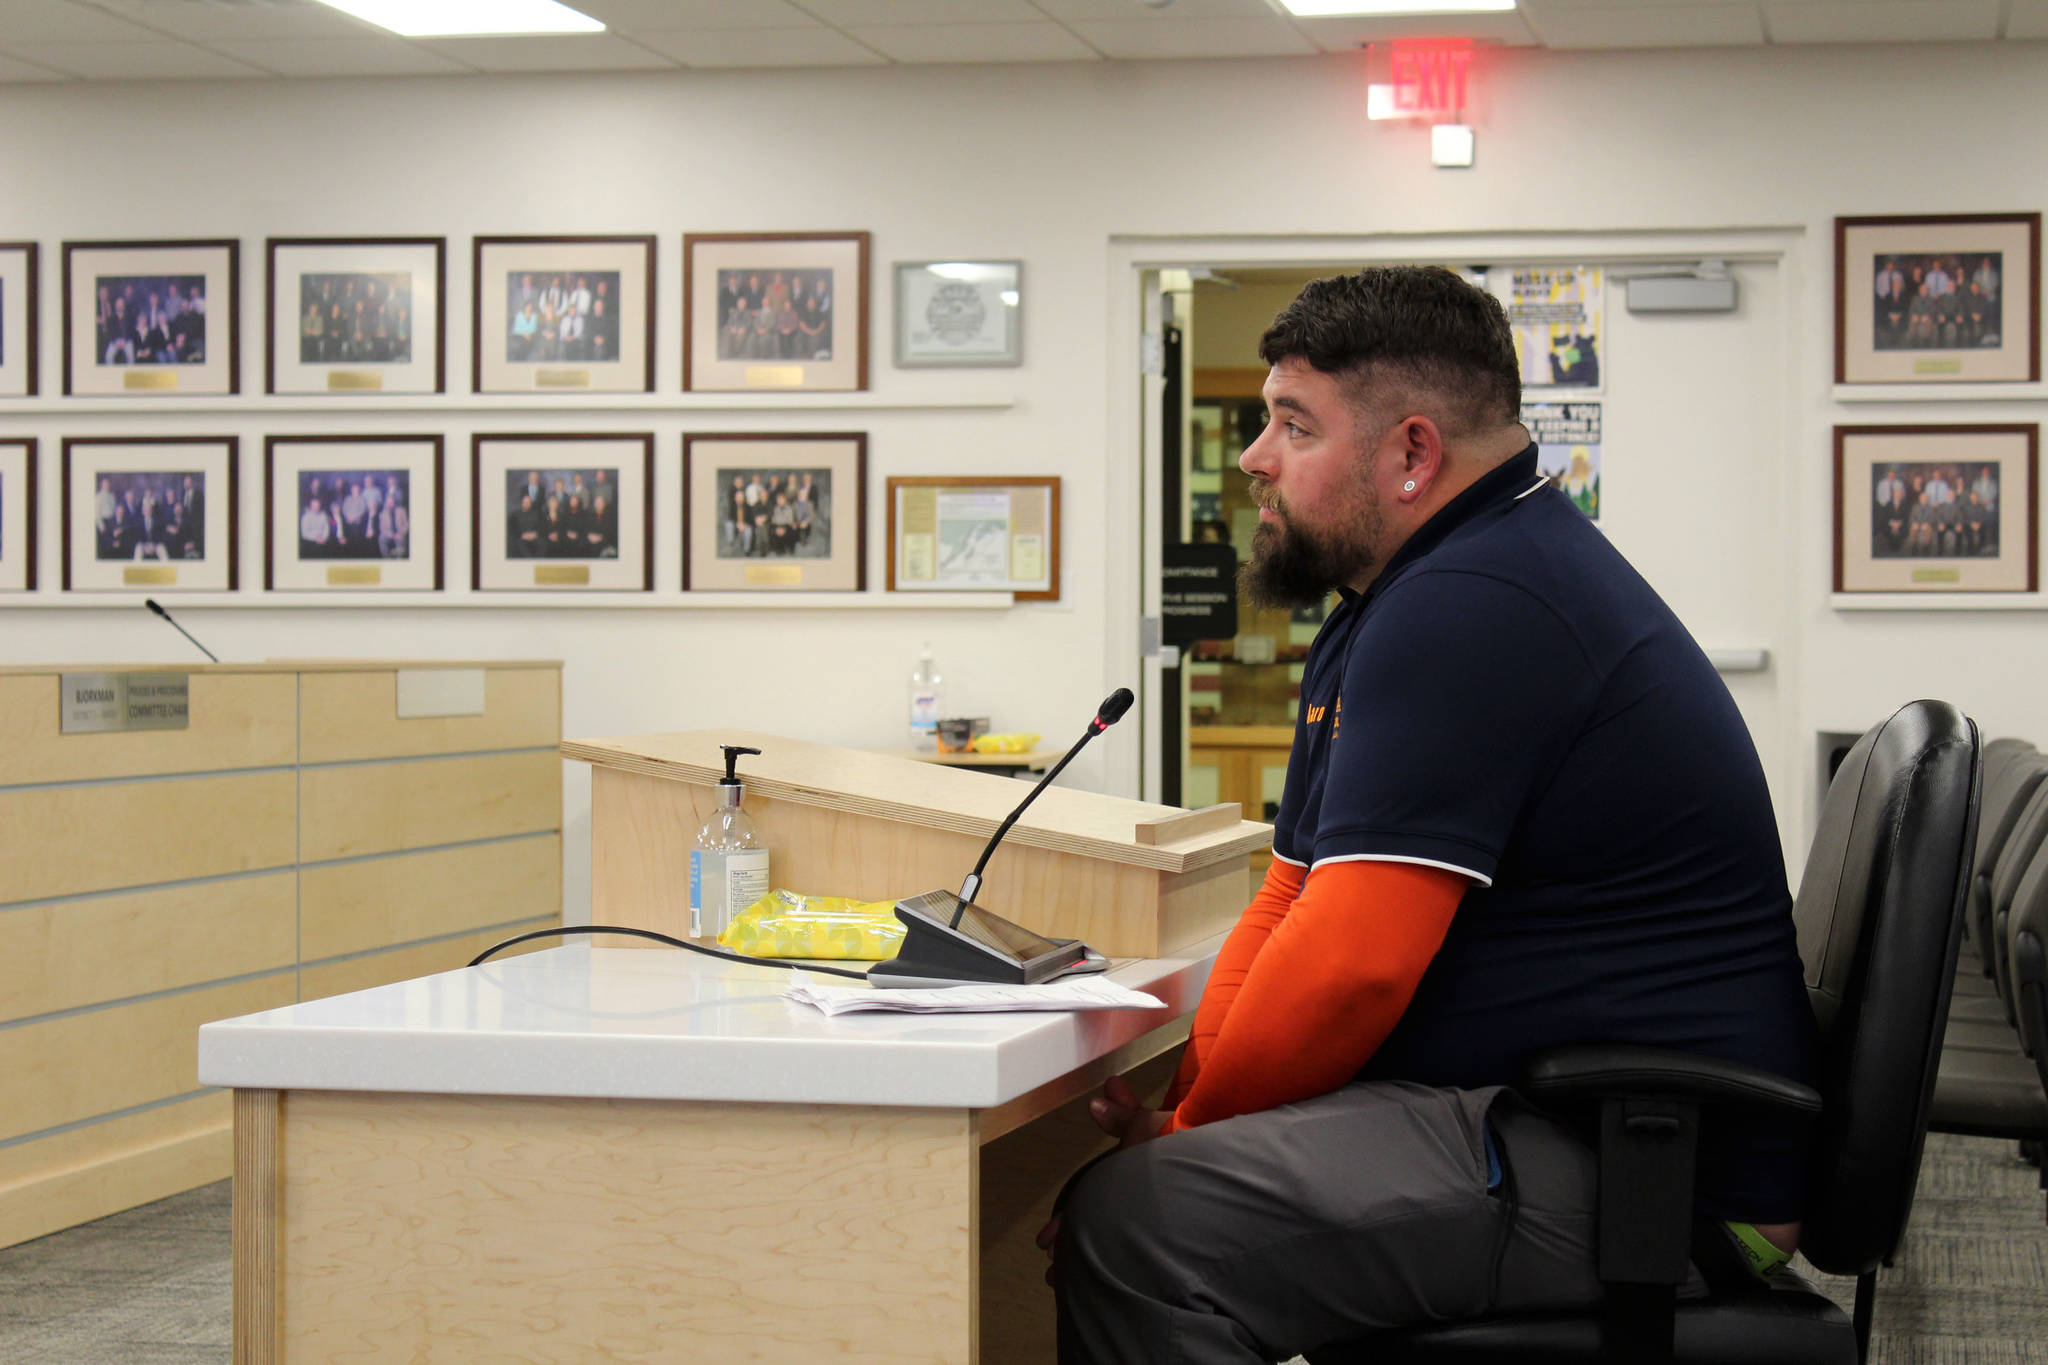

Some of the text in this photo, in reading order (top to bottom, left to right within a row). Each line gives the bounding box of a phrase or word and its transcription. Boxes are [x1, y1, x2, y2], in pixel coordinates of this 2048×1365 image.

[1393, 51, 1472, 112] EXIT
[75, 687, 115, 704] BJORKMAN
[128, 703, 167, 719] COMMITTEE
